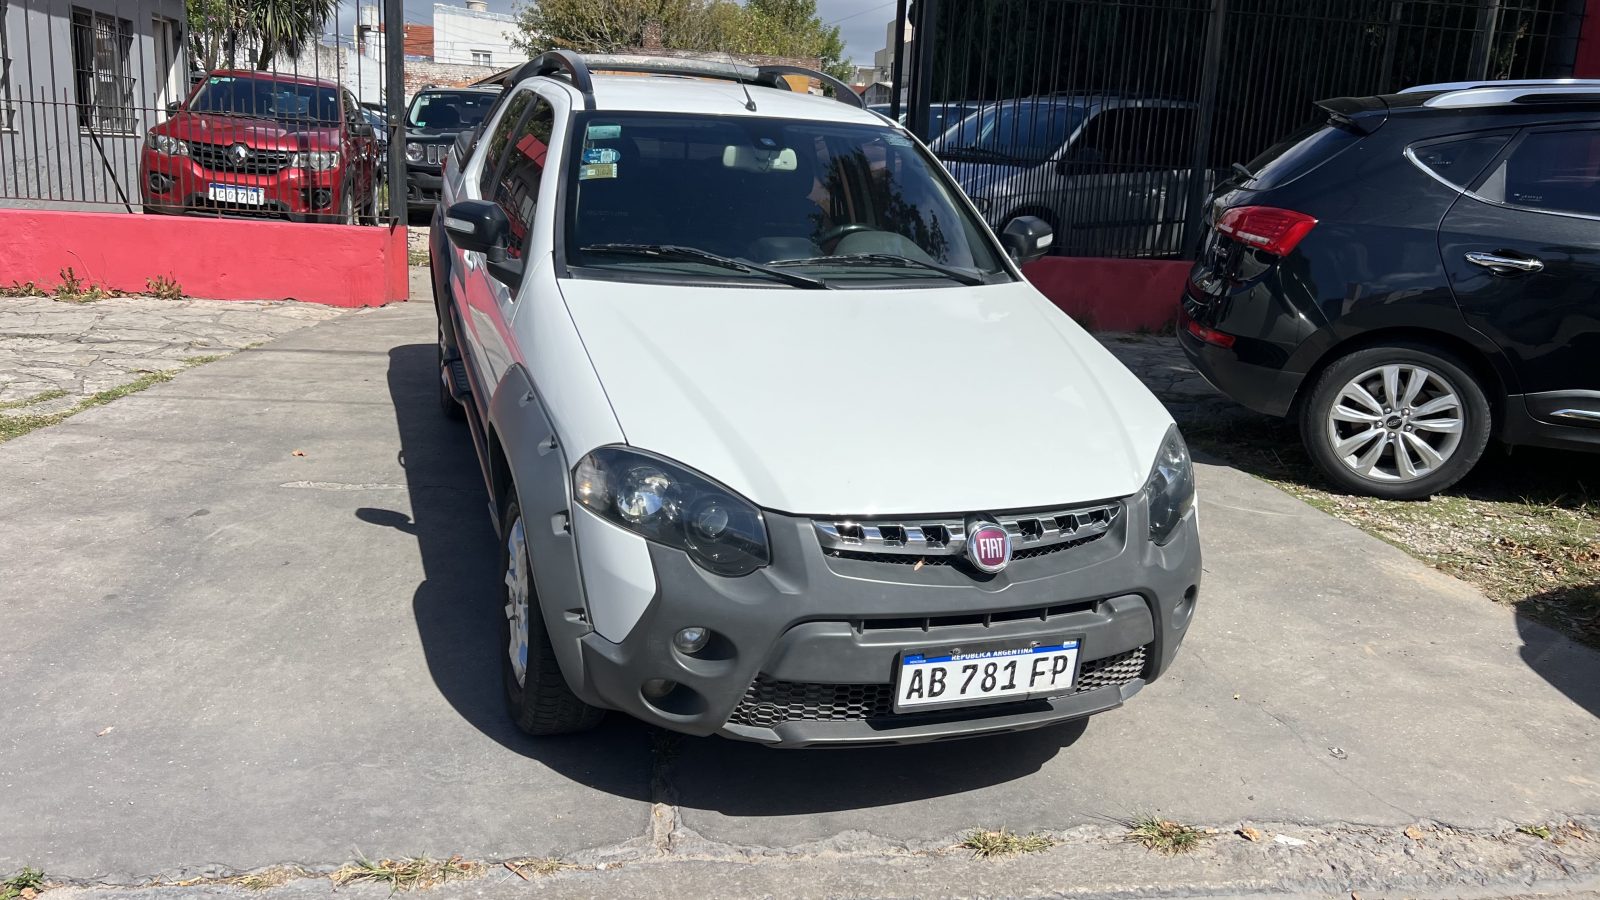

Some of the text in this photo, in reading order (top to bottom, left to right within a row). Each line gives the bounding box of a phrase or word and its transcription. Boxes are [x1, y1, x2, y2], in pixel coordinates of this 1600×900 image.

[980, 538, 1003, 558] FIAT
[951, 647, 1033, 661] REPUBLICA ARGENTINA
[906, 655, 1068, 699] AB 781 FP
